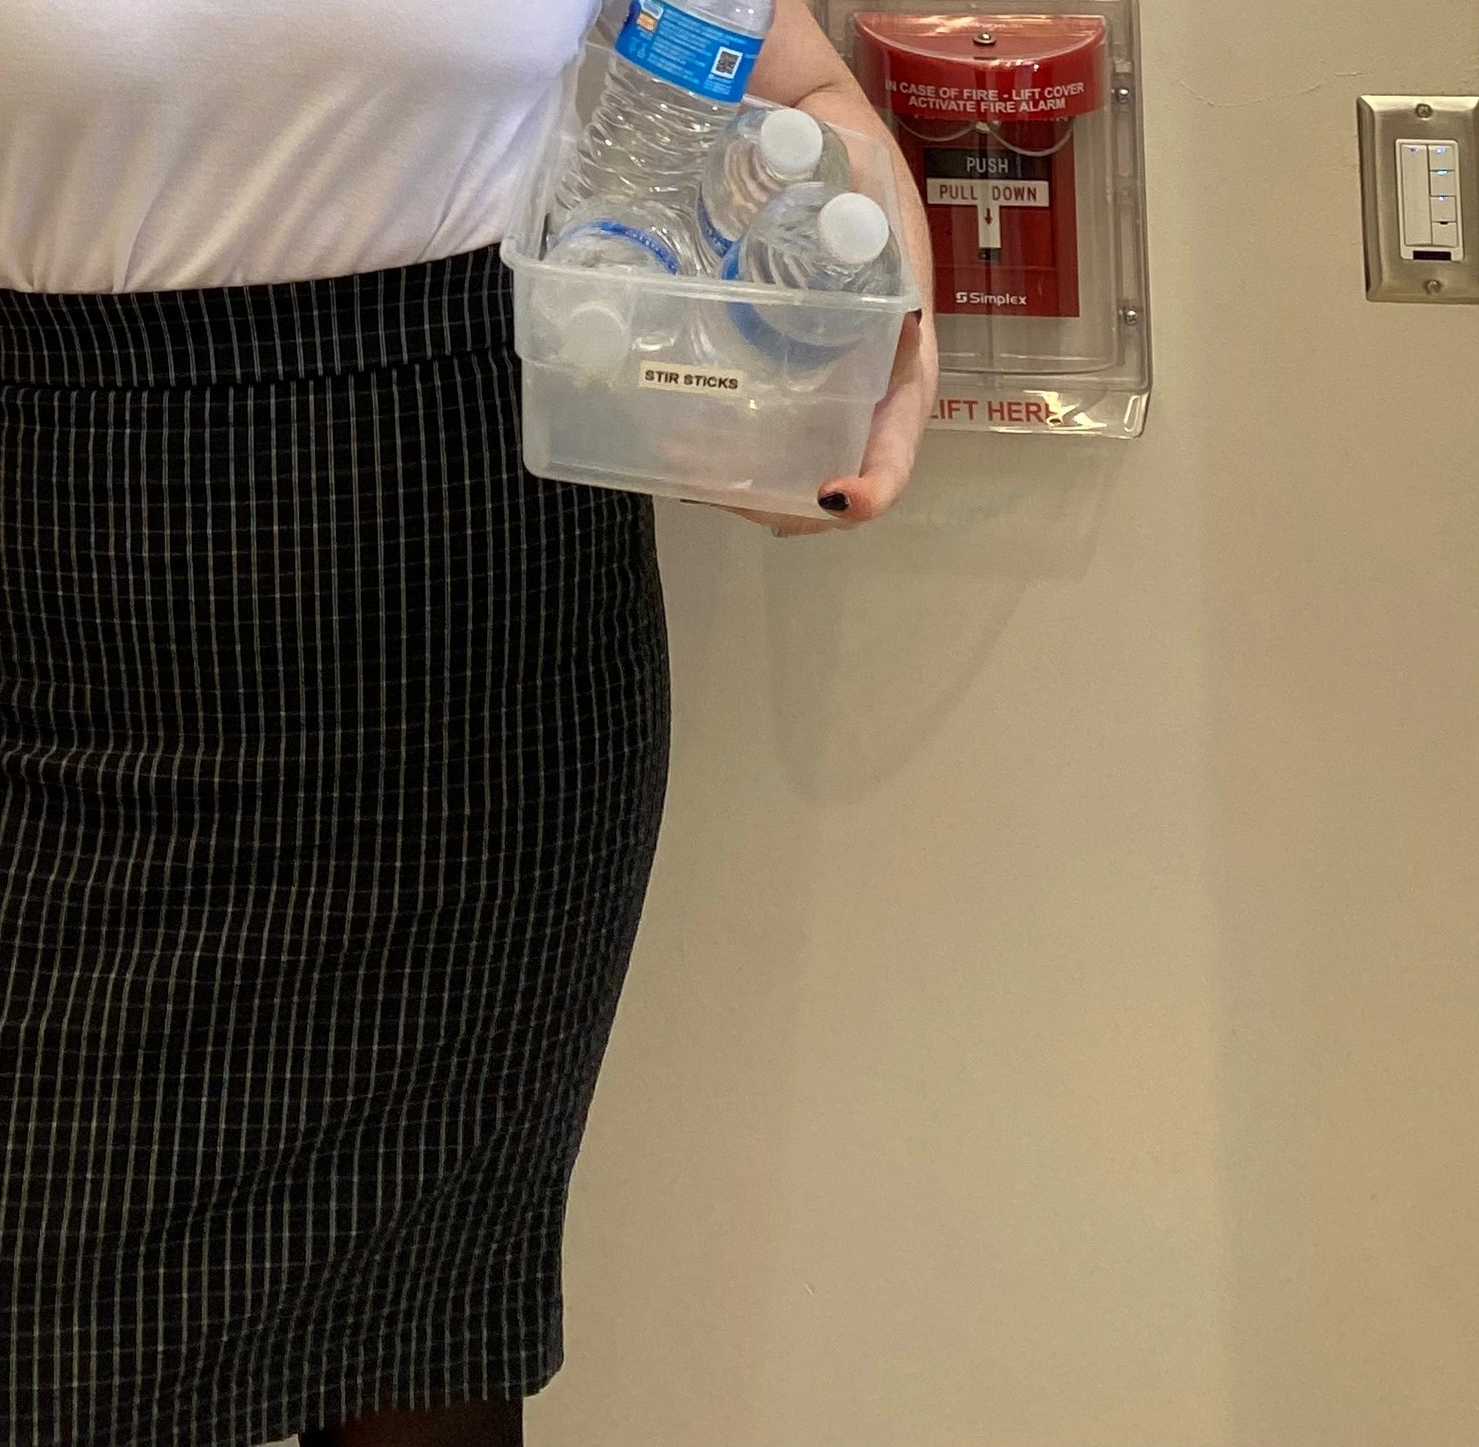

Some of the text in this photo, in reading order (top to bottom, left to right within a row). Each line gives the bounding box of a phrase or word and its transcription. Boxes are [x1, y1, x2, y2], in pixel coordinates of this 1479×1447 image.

[885, 79, 897, 91] IN
[899, 82, 936, 98] CASE
[939, 87, 959, 99] OF
[963, 88, 999, 101] FIRE
[1012, 88, 1041, 101] LIFT
[1044, 82, 1085, 98] COVER
[908, 96, 1066, 113] ACTIVATE FIRE ALARM
[966, 156, 1009, 173] PUSH
[939, 184, 1037, 202] PULL DOWN
[969, 292, 1027, 306] Simplex
[645, 370, 739, 390] STIR STICKS
